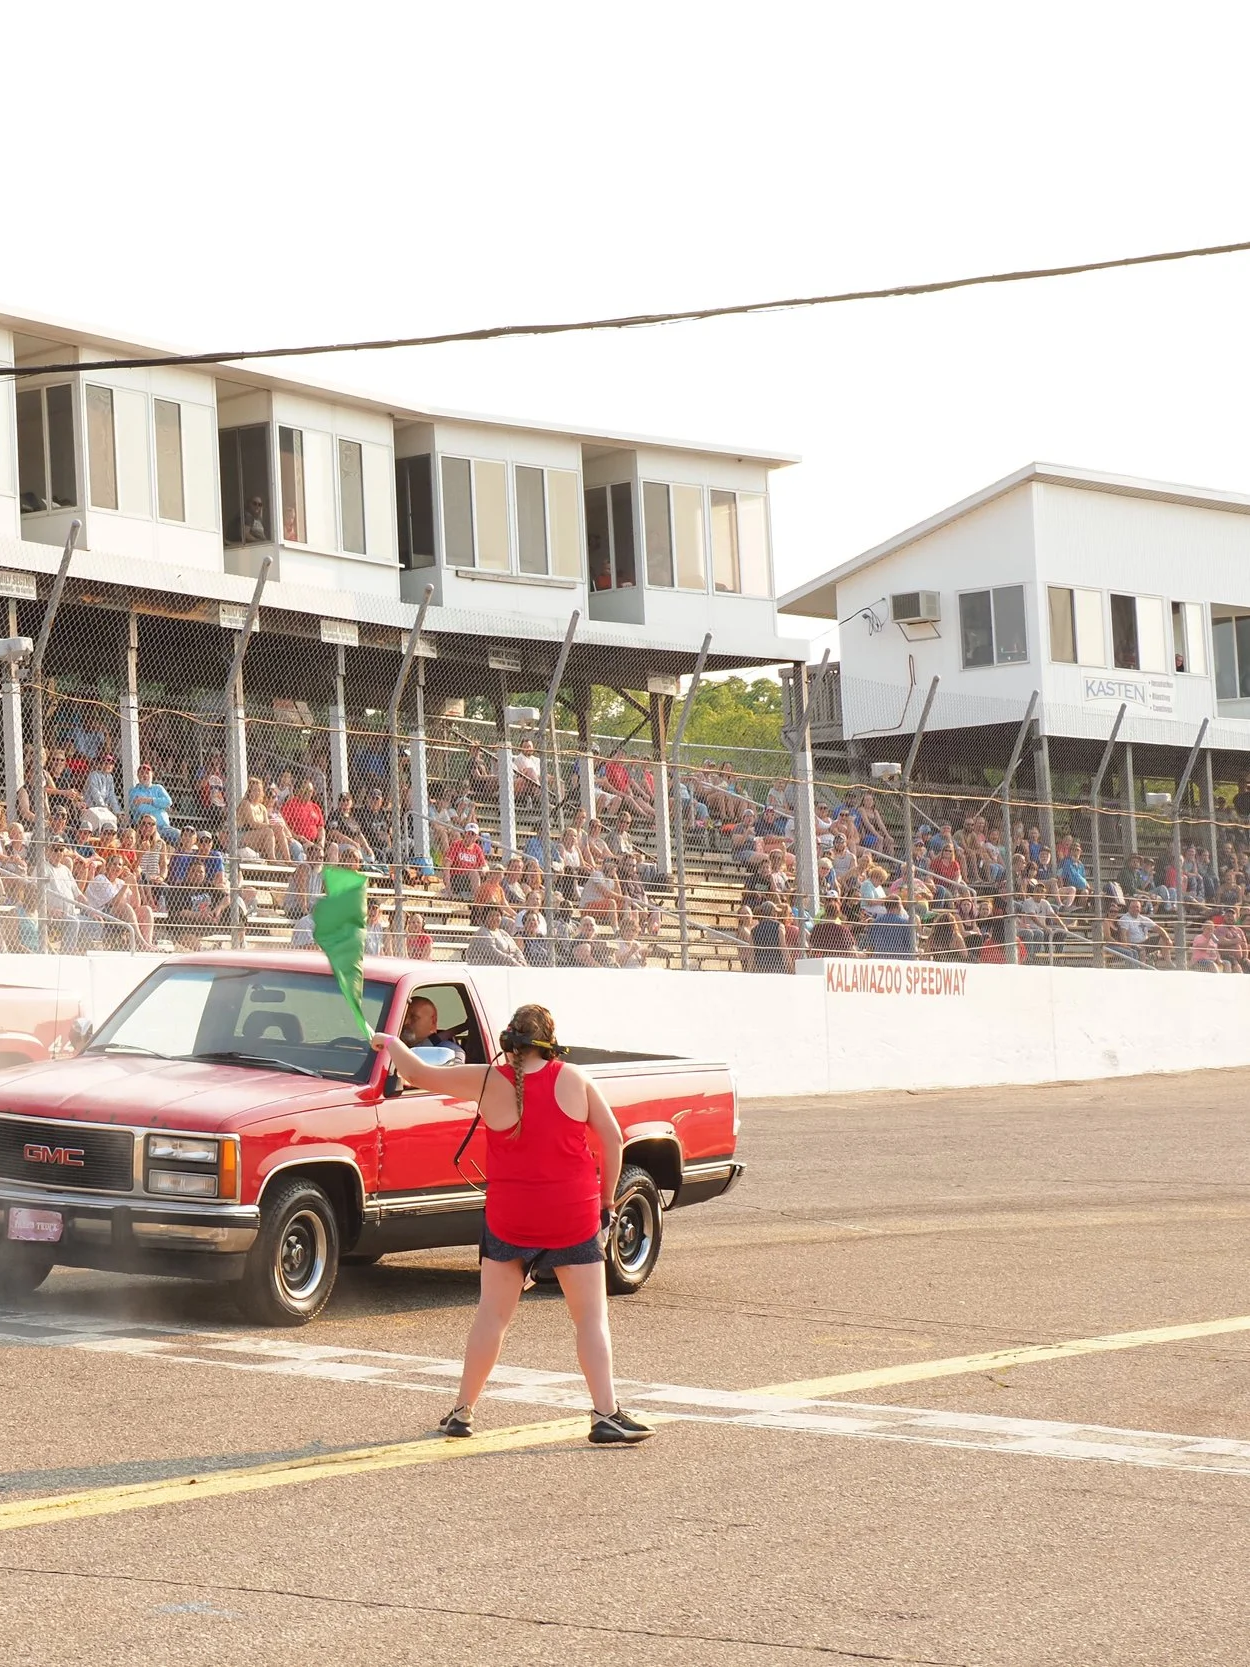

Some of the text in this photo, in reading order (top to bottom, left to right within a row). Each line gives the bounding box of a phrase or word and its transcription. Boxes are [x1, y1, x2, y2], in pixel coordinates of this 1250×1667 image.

[1085, 680, 1146, 704] KASTEN
[827, 963, 967, 996] KALAMAZOO SPEEDWAY
[23, 1143, 85, 1167] GMC
